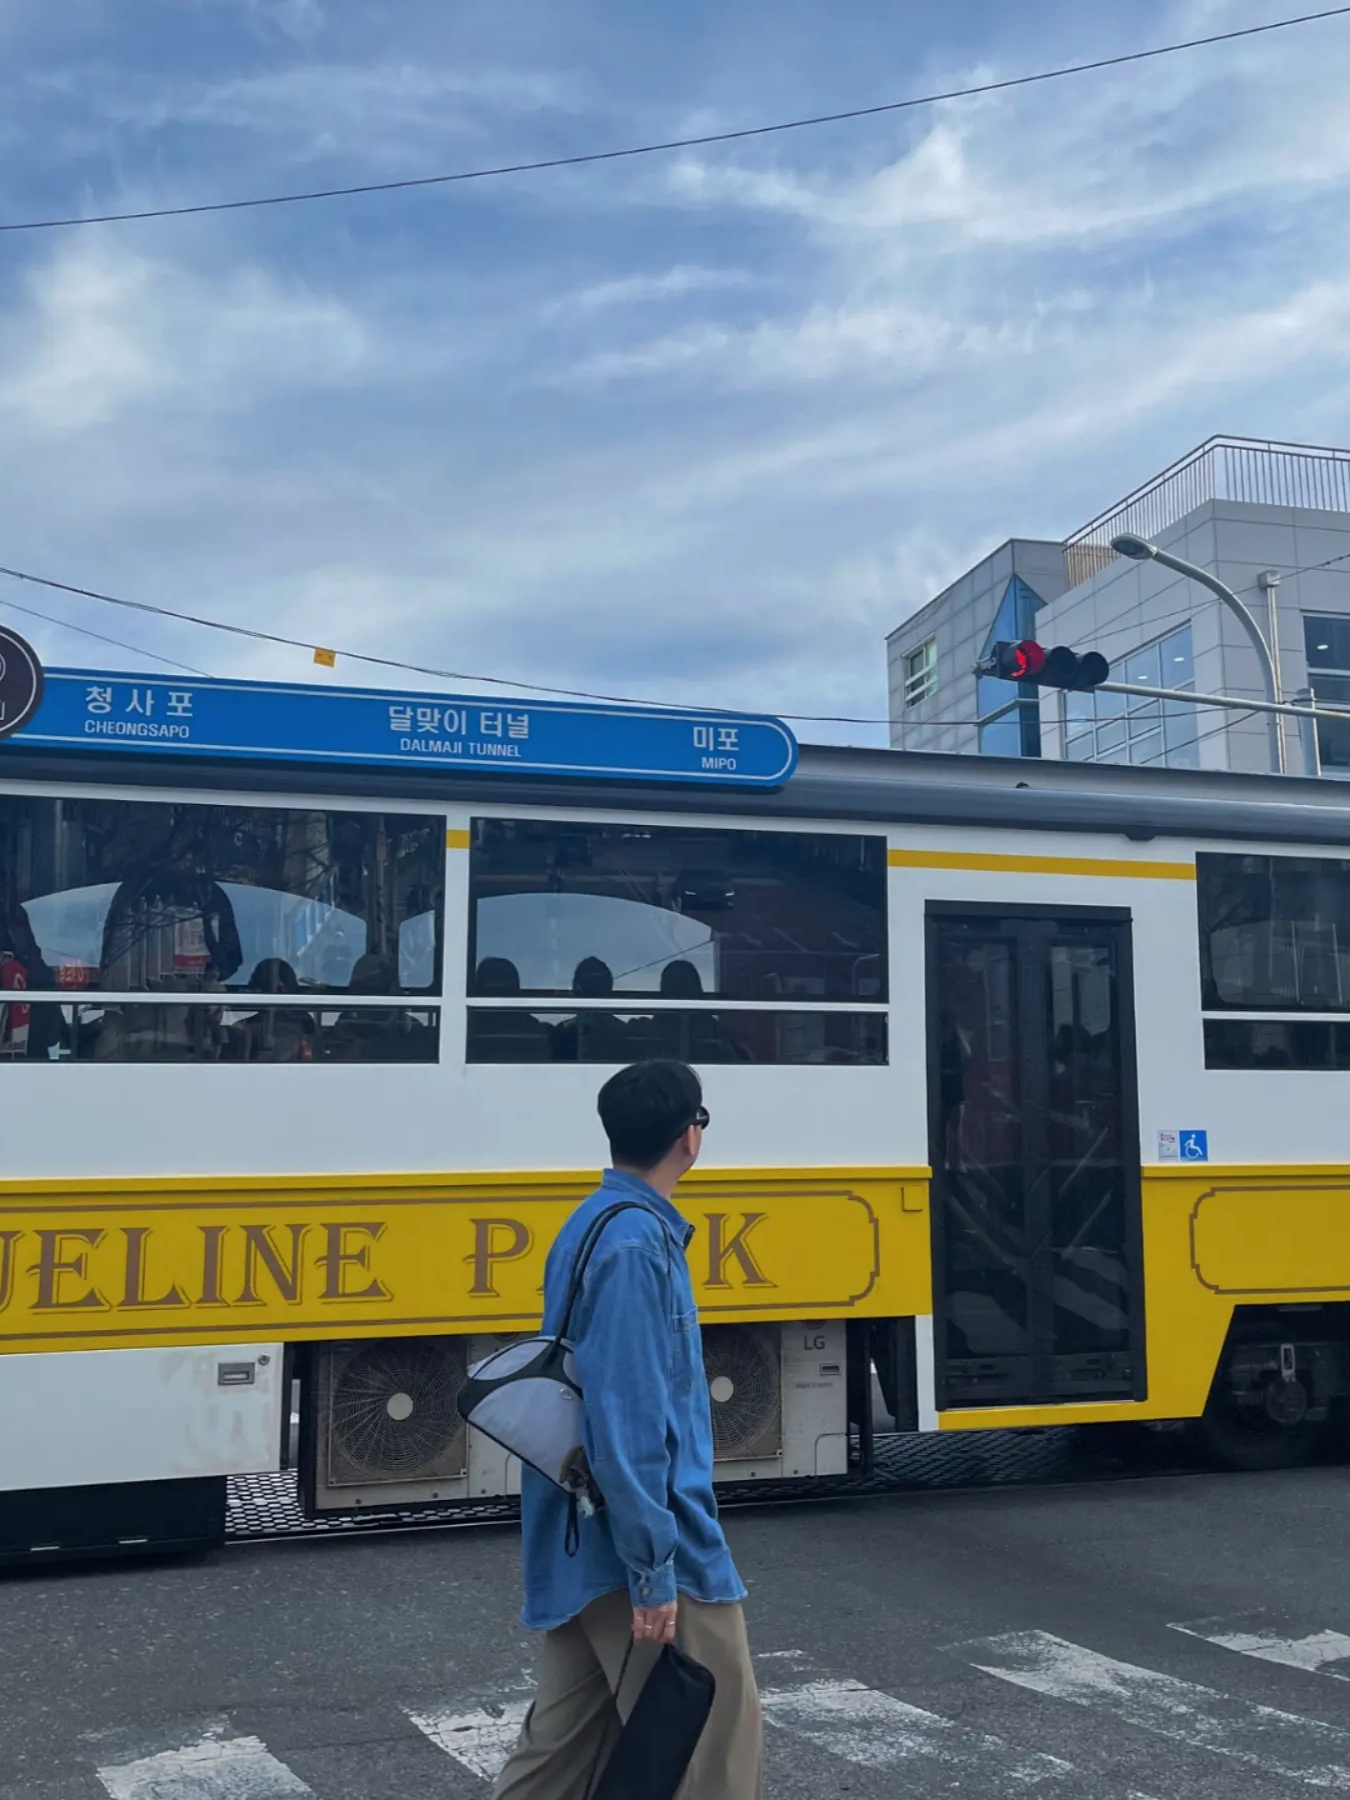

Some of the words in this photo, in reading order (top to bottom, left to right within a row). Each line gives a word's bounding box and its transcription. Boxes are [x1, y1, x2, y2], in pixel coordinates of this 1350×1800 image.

[84, 719, 189, 738] CHEONGSAPO
[388, 705, 467, 735] 달맞이
[480, 711, 530, 739] 터널
[400, 737, 463, 755] DALMAJI
[468, 741, 522, 758] TUNNEL
[693, 726, 740, 752] 미포
[701, 756, 738, 772] MIPO
[463, 1212, 778, 1298] PK
[803, 1334, 826, 1351] LG
